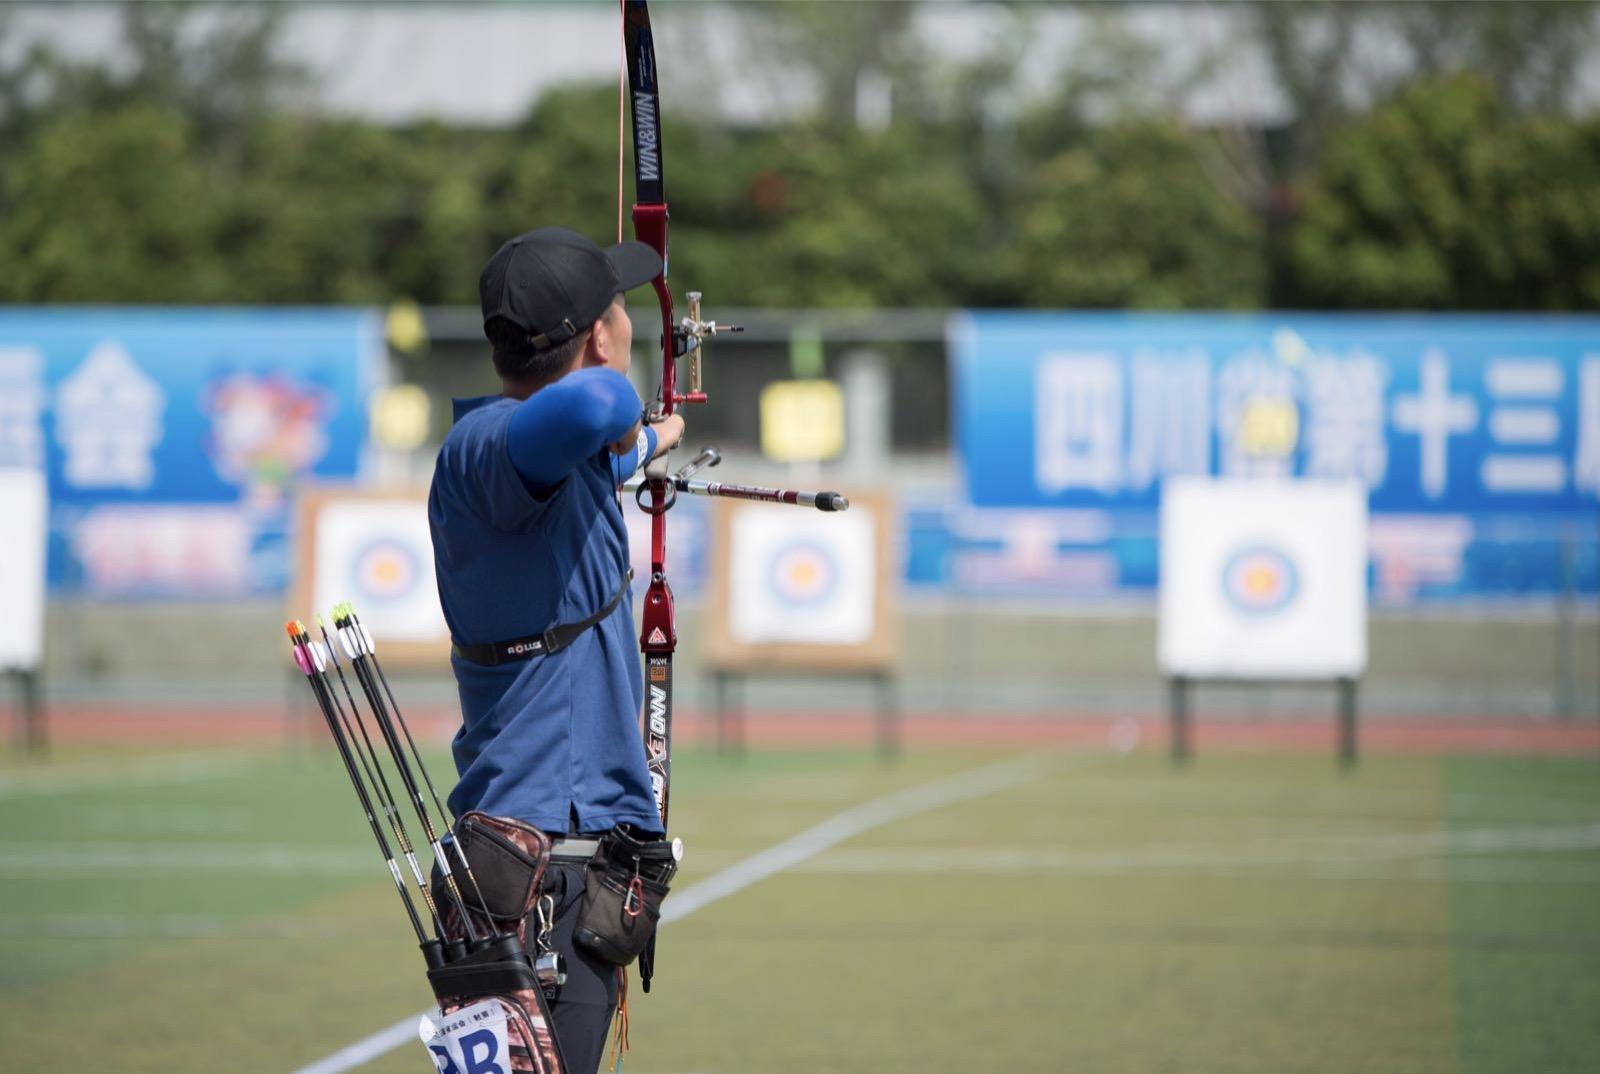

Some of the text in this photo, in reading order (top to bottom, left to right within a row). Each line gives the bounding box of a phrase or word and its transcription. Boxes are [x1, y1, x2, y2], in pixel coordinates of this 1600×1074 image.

[635, 92, 659, 181] WIN&WIN
[1033, 346, 1600, 498] 四川省第十三
[650, 684, 667, 735] INNO
